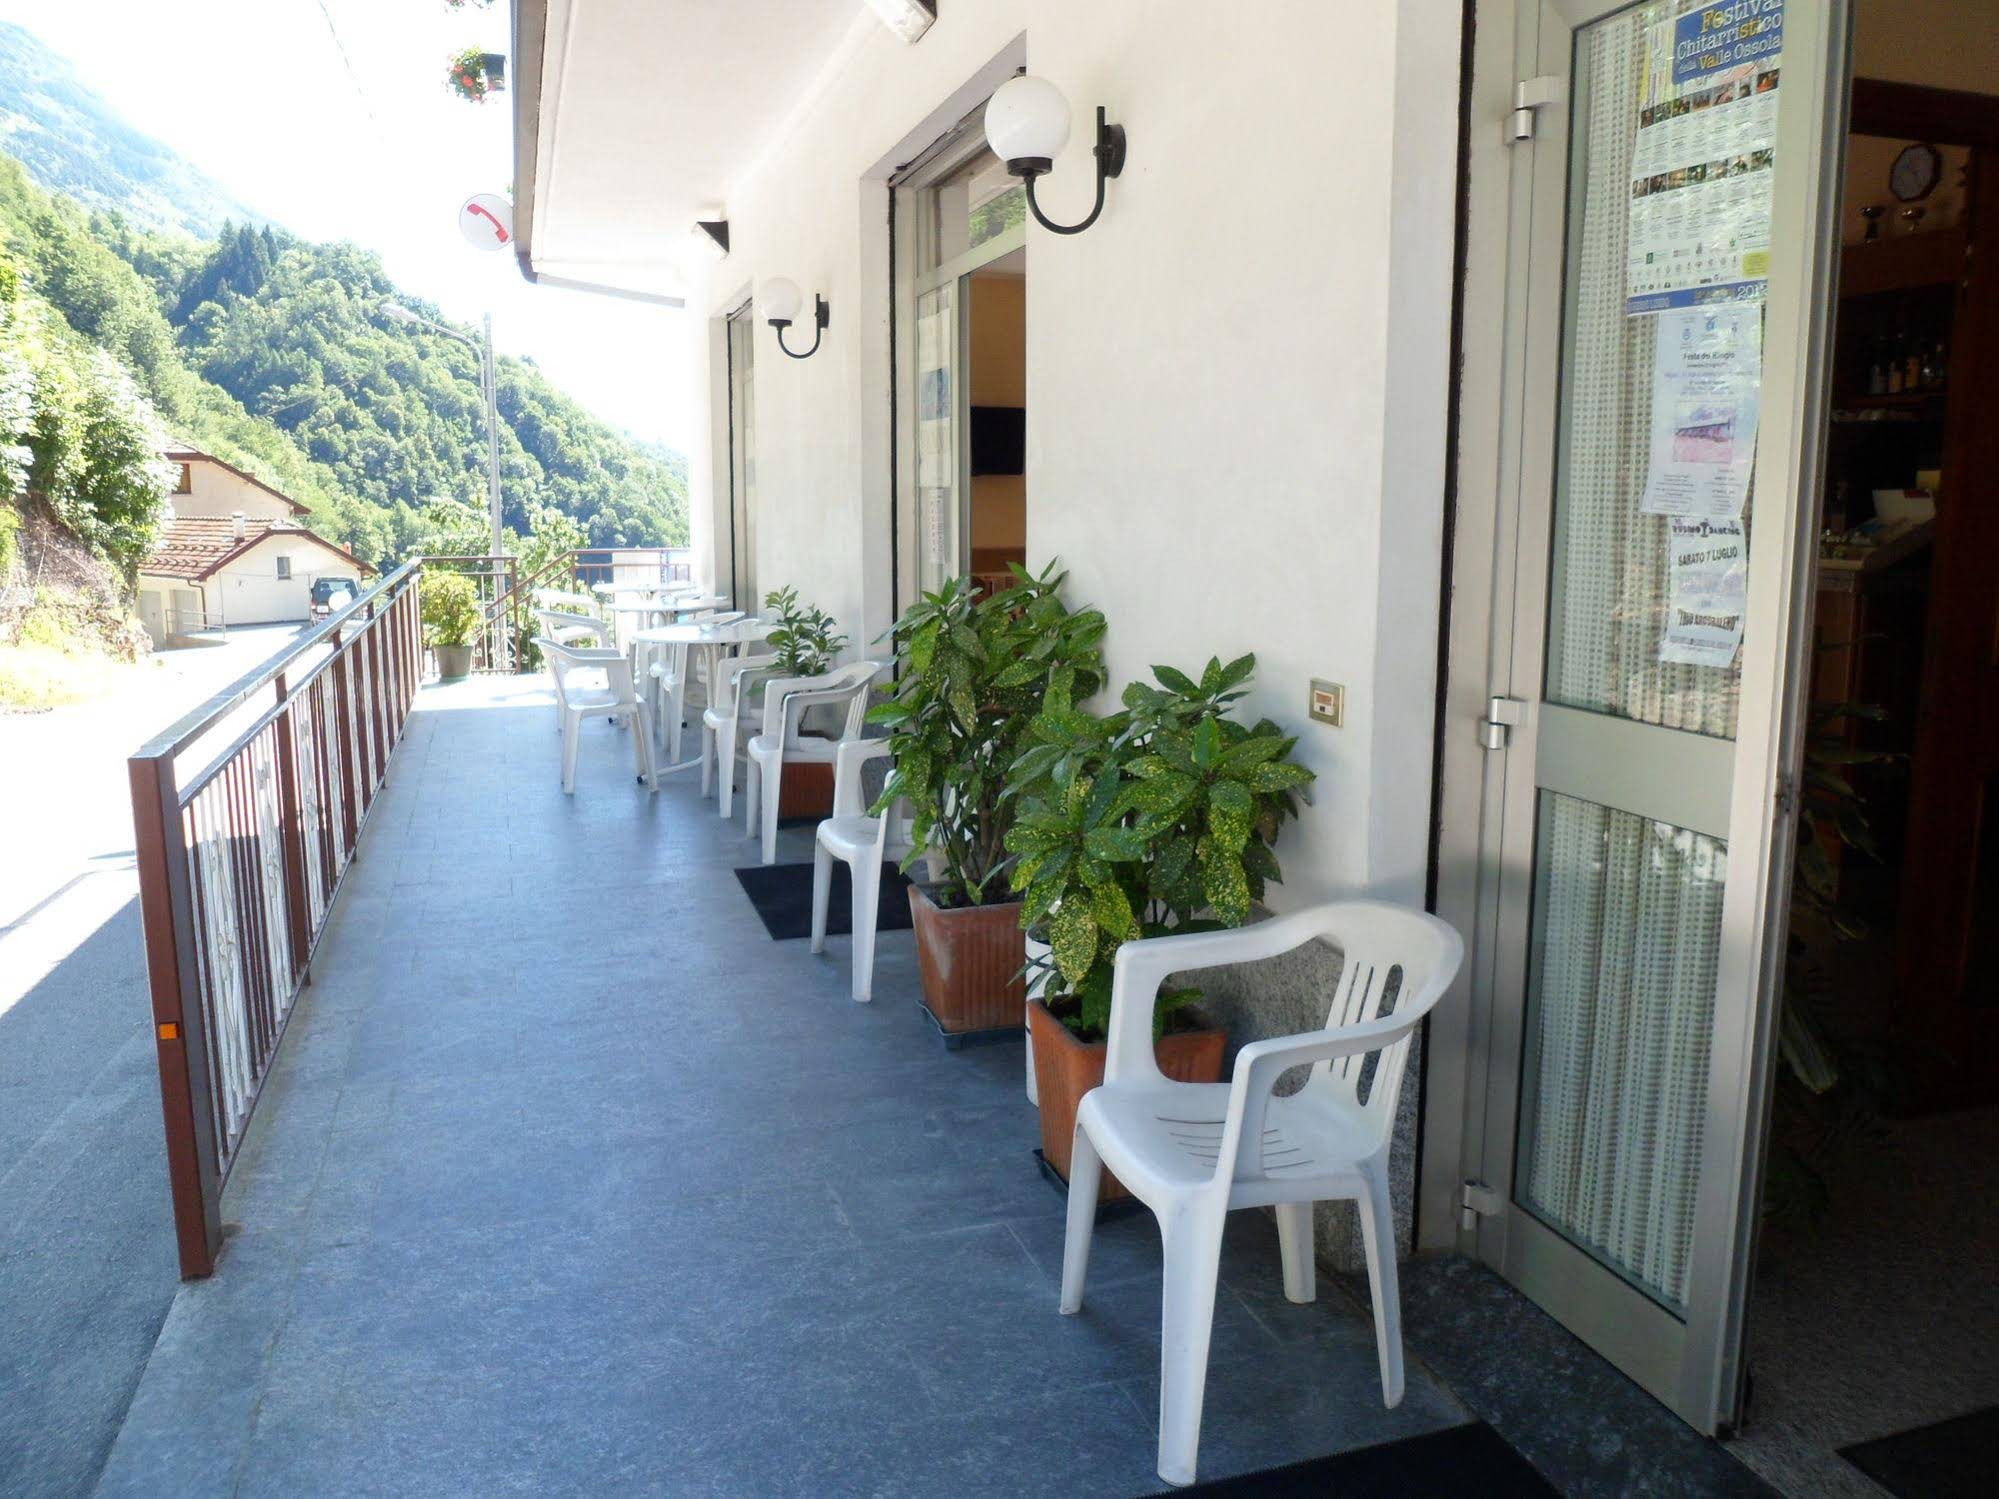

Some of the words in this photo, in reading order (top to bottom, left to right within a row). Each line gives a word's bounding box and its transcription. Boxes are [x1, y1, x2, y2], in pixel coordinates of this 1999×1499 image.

[1677, 13, 1781, 60] Chitarristico
[1699, 49, 1731, 69] Valle
[1734, 34, 1780, 60] Ossola
[1678, 552, 1704, 566] SABATO
[1712, 546, 1737, 561] LUGLIO
